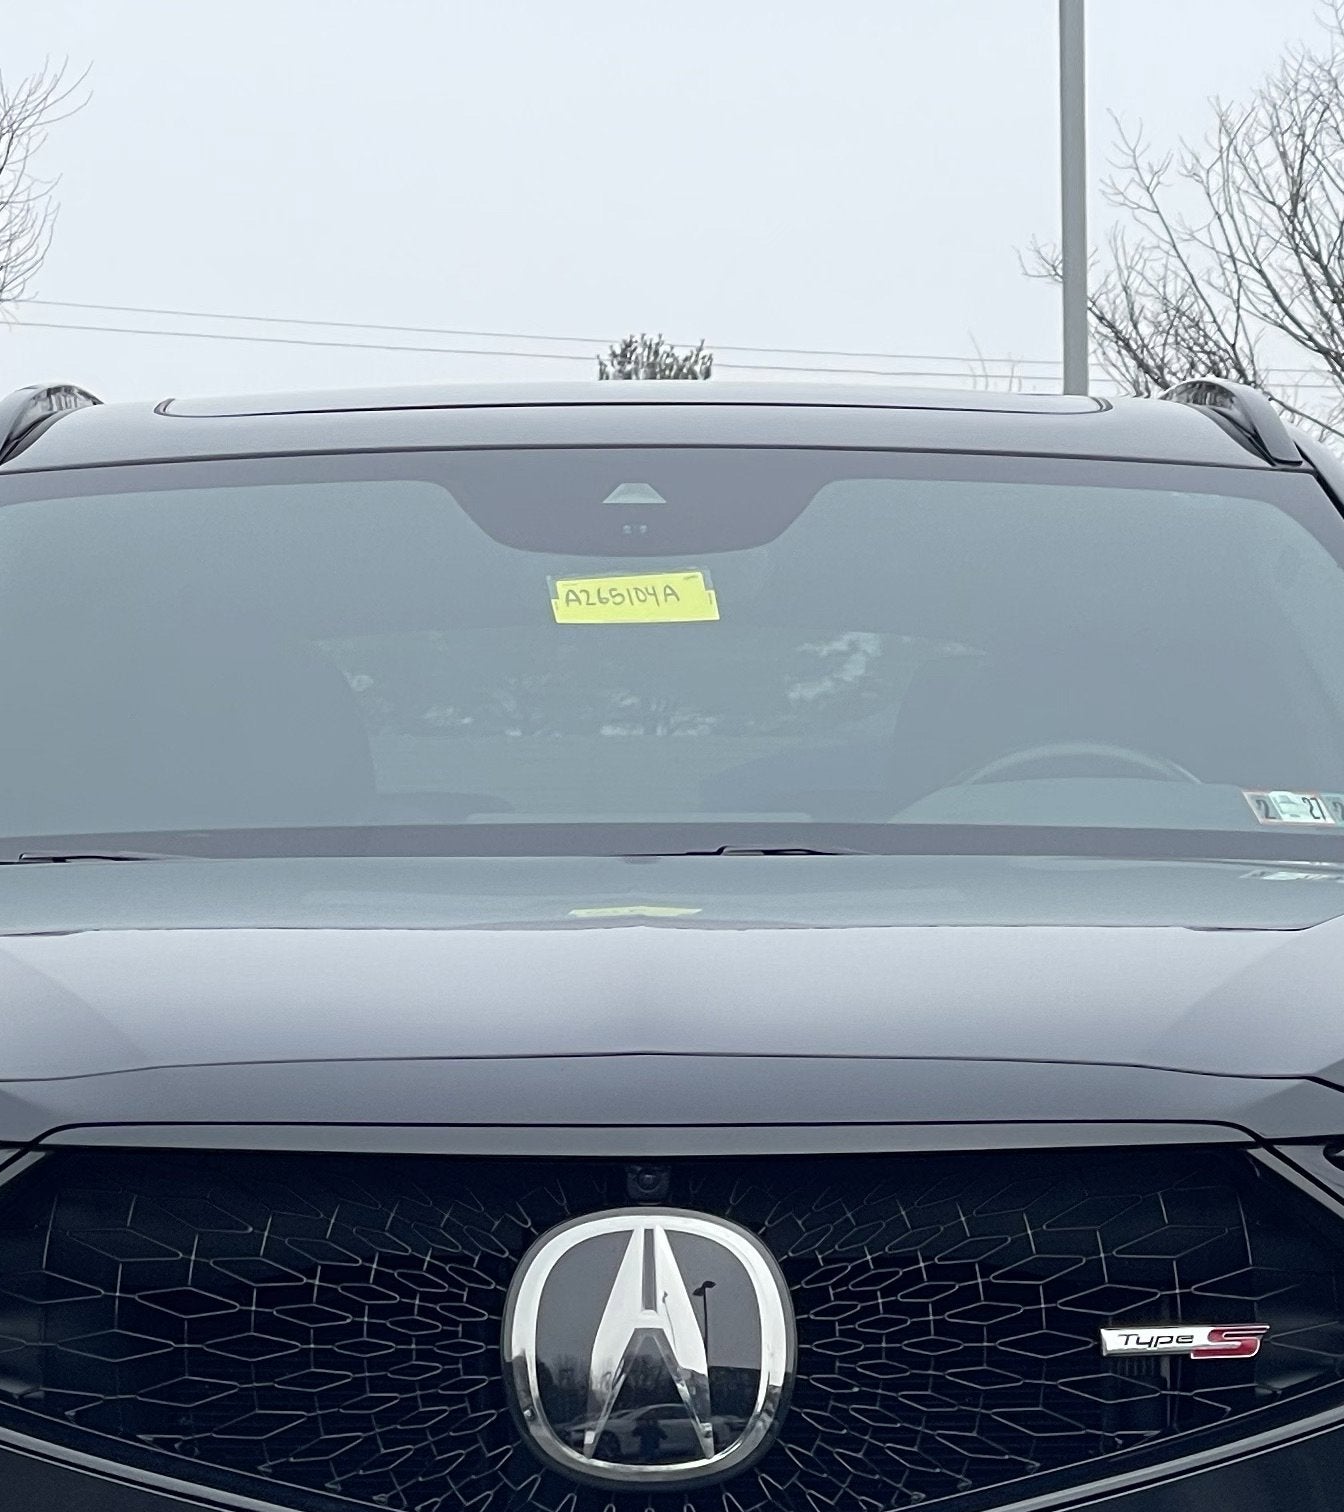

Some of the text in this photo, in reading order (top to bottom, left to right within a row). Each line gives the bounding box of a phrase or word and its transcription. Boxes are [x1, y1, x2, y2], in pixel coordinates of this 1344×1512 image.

[564, 584, 681, 608] A265104A
[1301, 796, 1327, 821] 27
[1117, 1324, 1271, 1360] Type S
